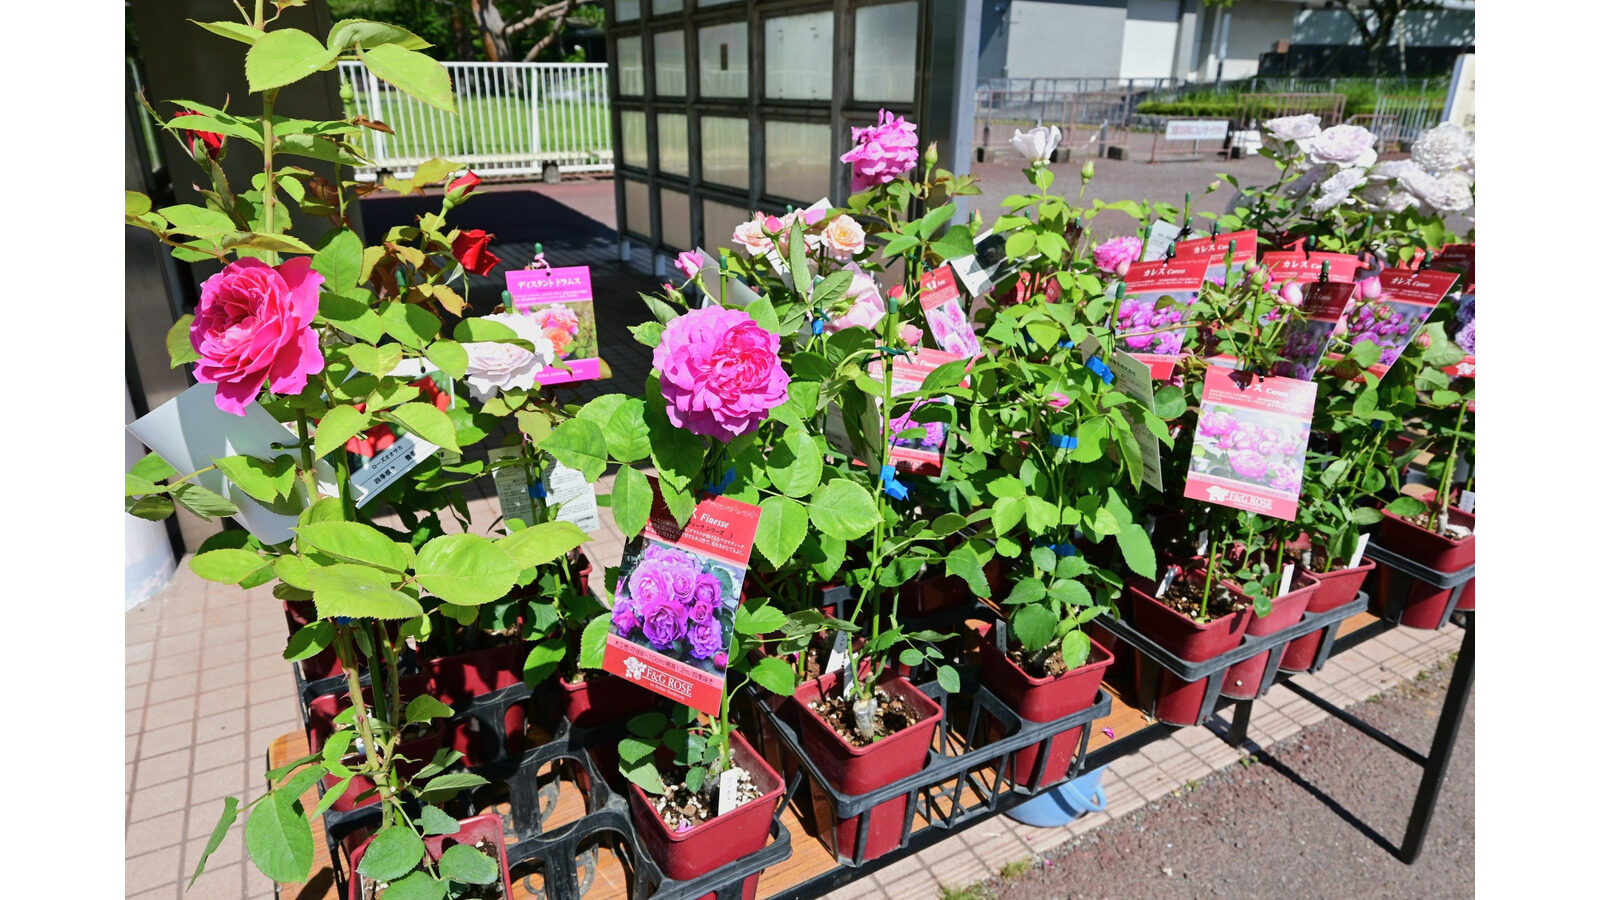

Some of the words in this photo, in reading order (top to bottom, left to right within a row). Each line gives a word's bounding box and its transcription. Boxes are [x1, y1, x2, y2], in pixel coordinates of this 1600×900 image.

[1143, 268, 1166, 277] カレス
[555, 277, 581, 287] ドラムス
[1391, 277, 1413, 285] カレス
[700, 513, 730, 529] Finesse
[646, 667, 666, 685] F&G
[667, 678, 694, 695] ROSE
